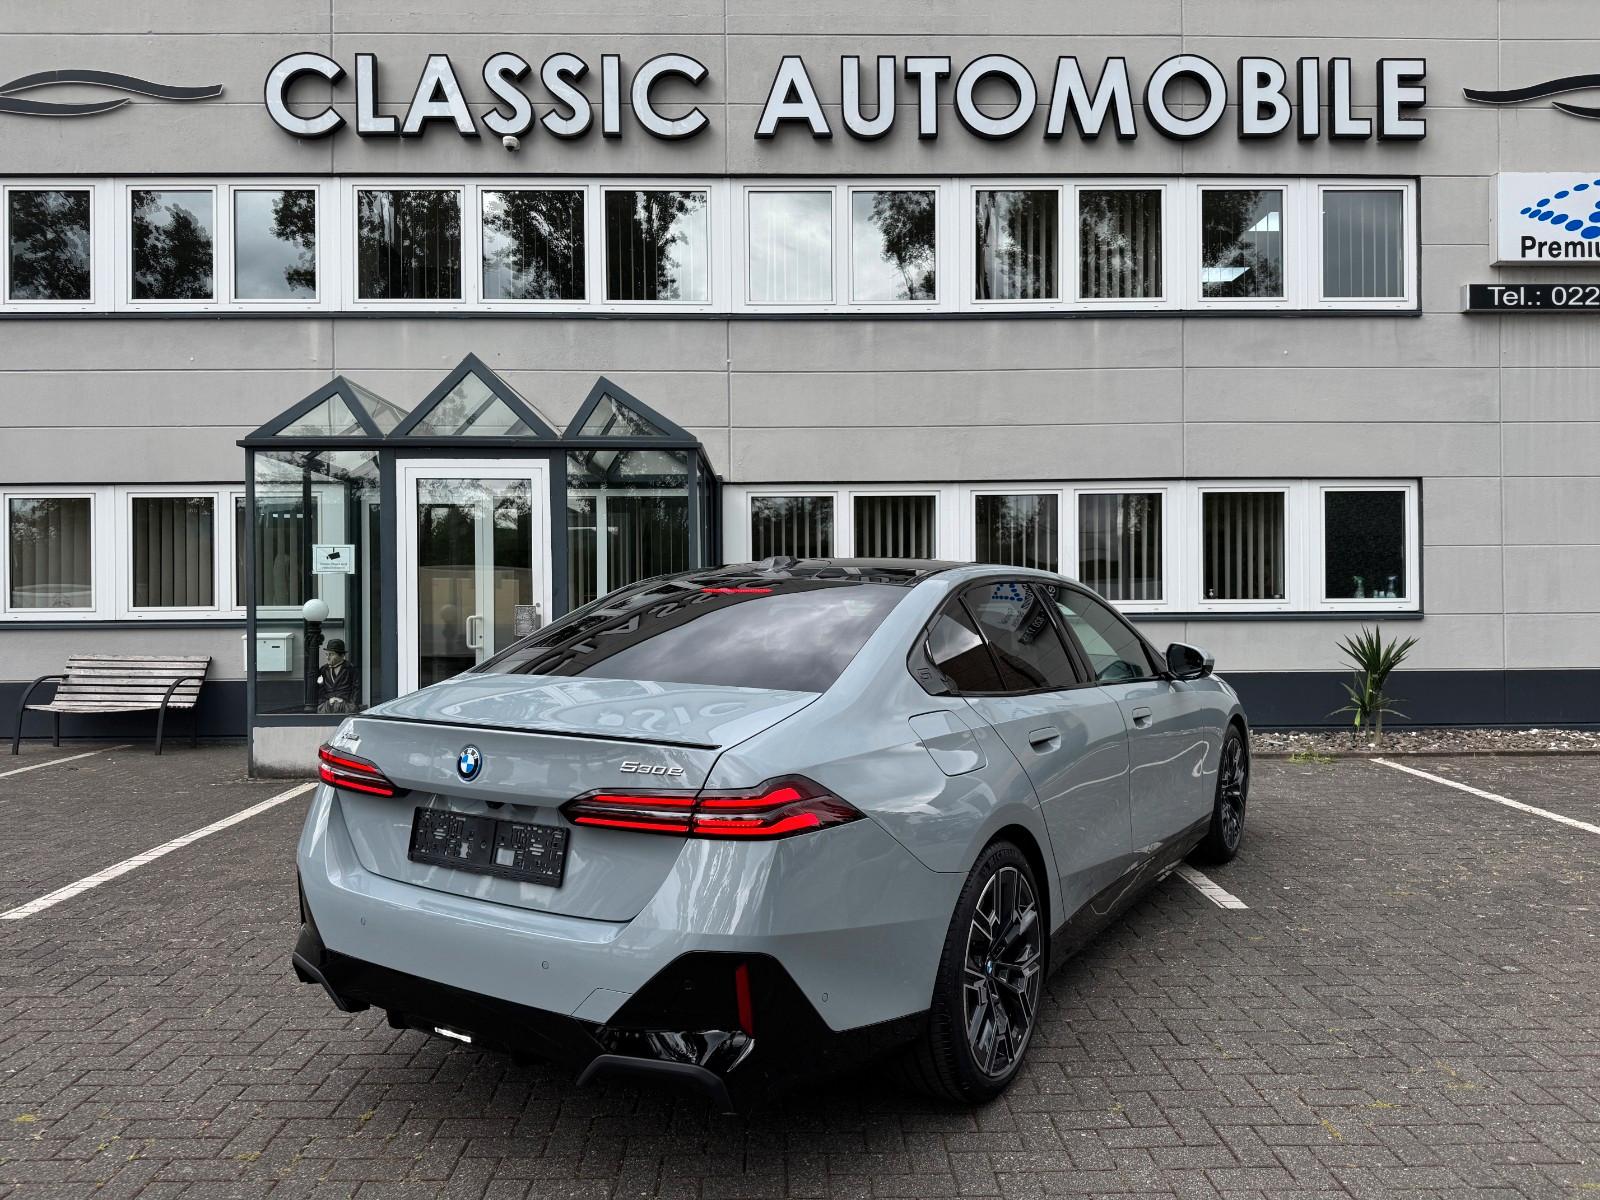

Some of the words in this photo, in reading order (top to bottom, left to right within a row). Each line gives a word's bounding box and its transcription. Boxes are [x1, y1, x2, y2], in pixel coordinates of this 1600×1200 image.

[264, 52, 711, 140] CLASSIC
[754, 53, 1427, 140] AUTOMOBILE
[1487, 286, 1541, 306] Tel.:
[1551, 286, 1600, 306] 022
